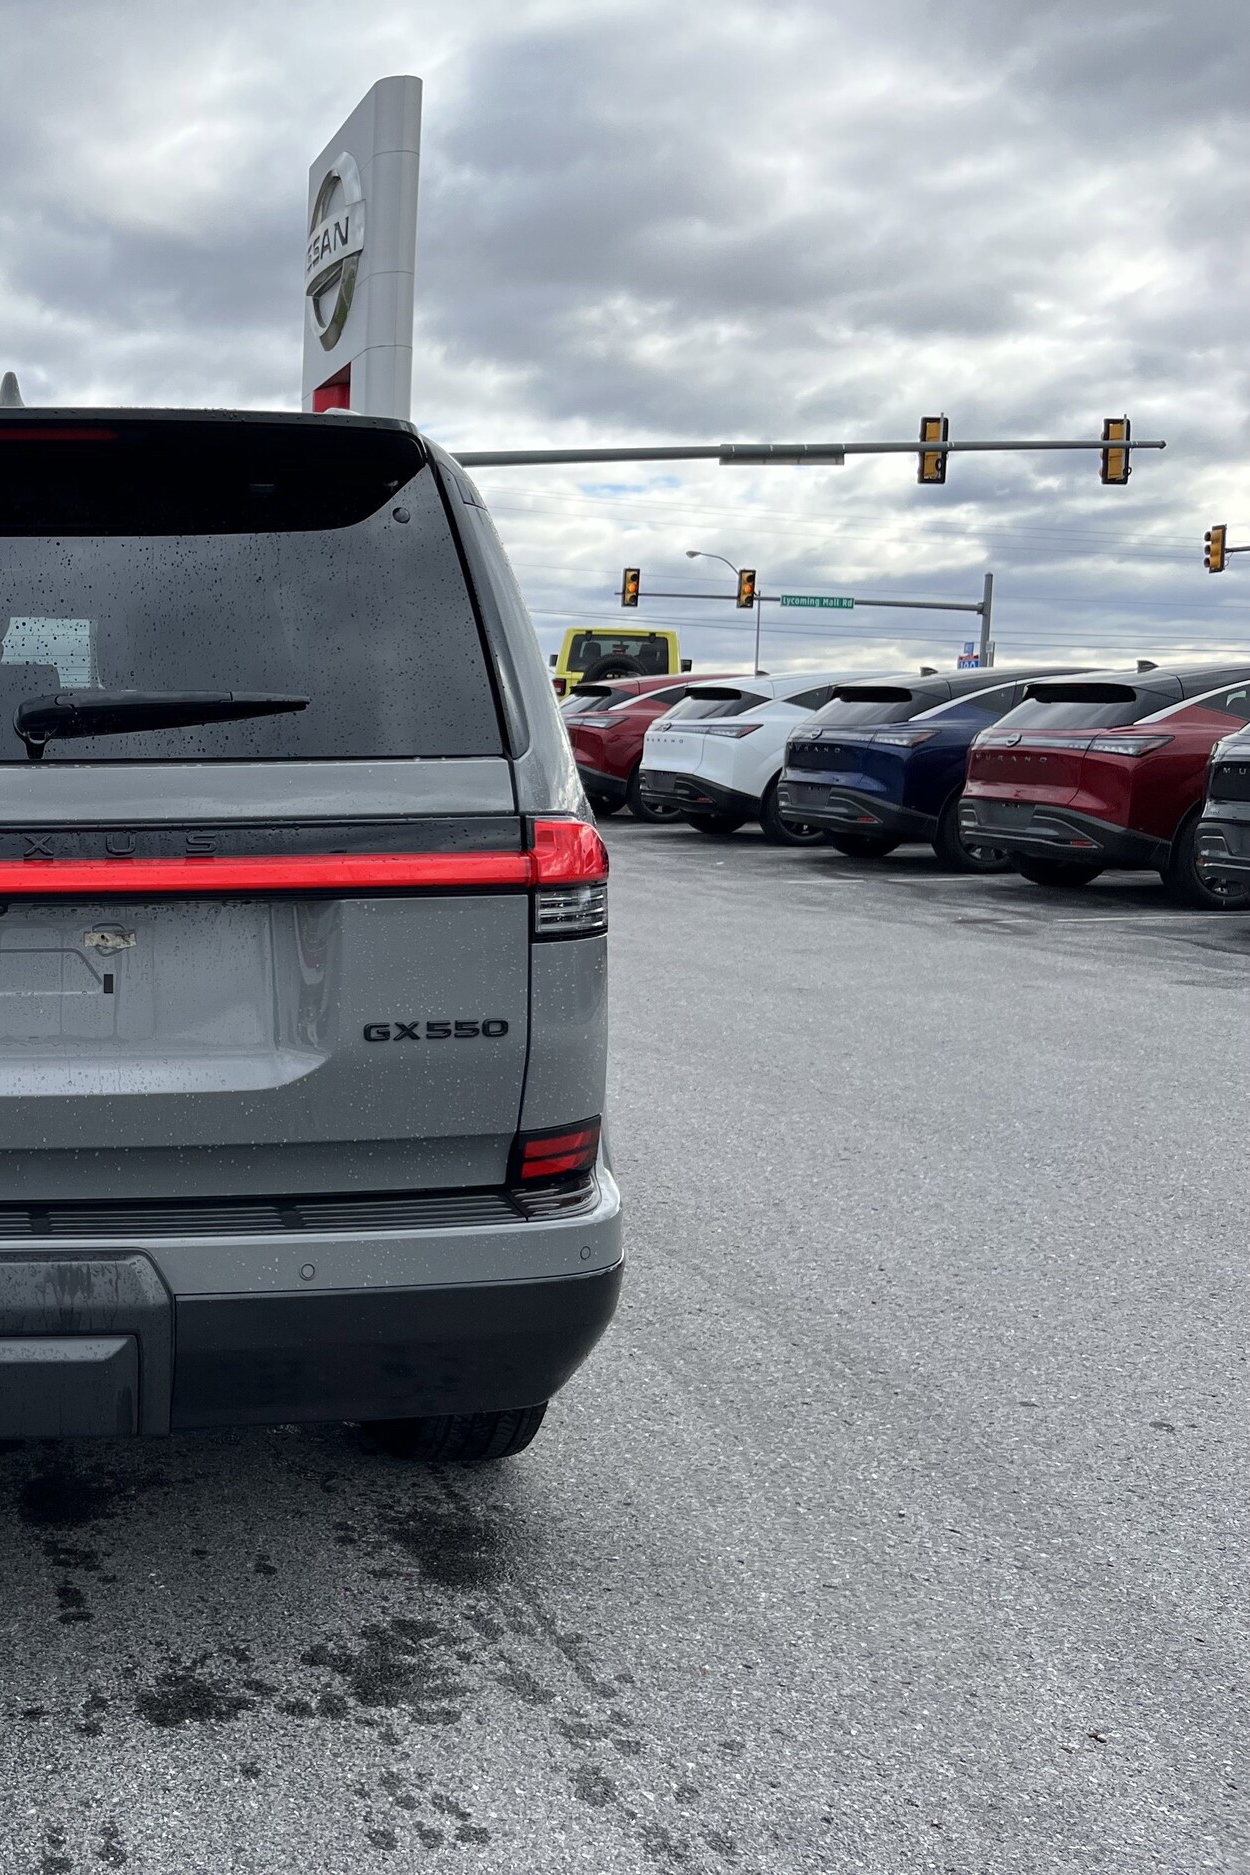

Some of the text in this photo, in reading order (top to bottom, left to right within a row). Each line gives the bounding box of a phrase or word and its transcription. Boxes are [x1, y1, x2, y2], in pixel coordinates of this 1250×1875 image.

[307, 216, 349, 272] SSAN
[783, 597, 853, 607] Lycoming Mall Rd
